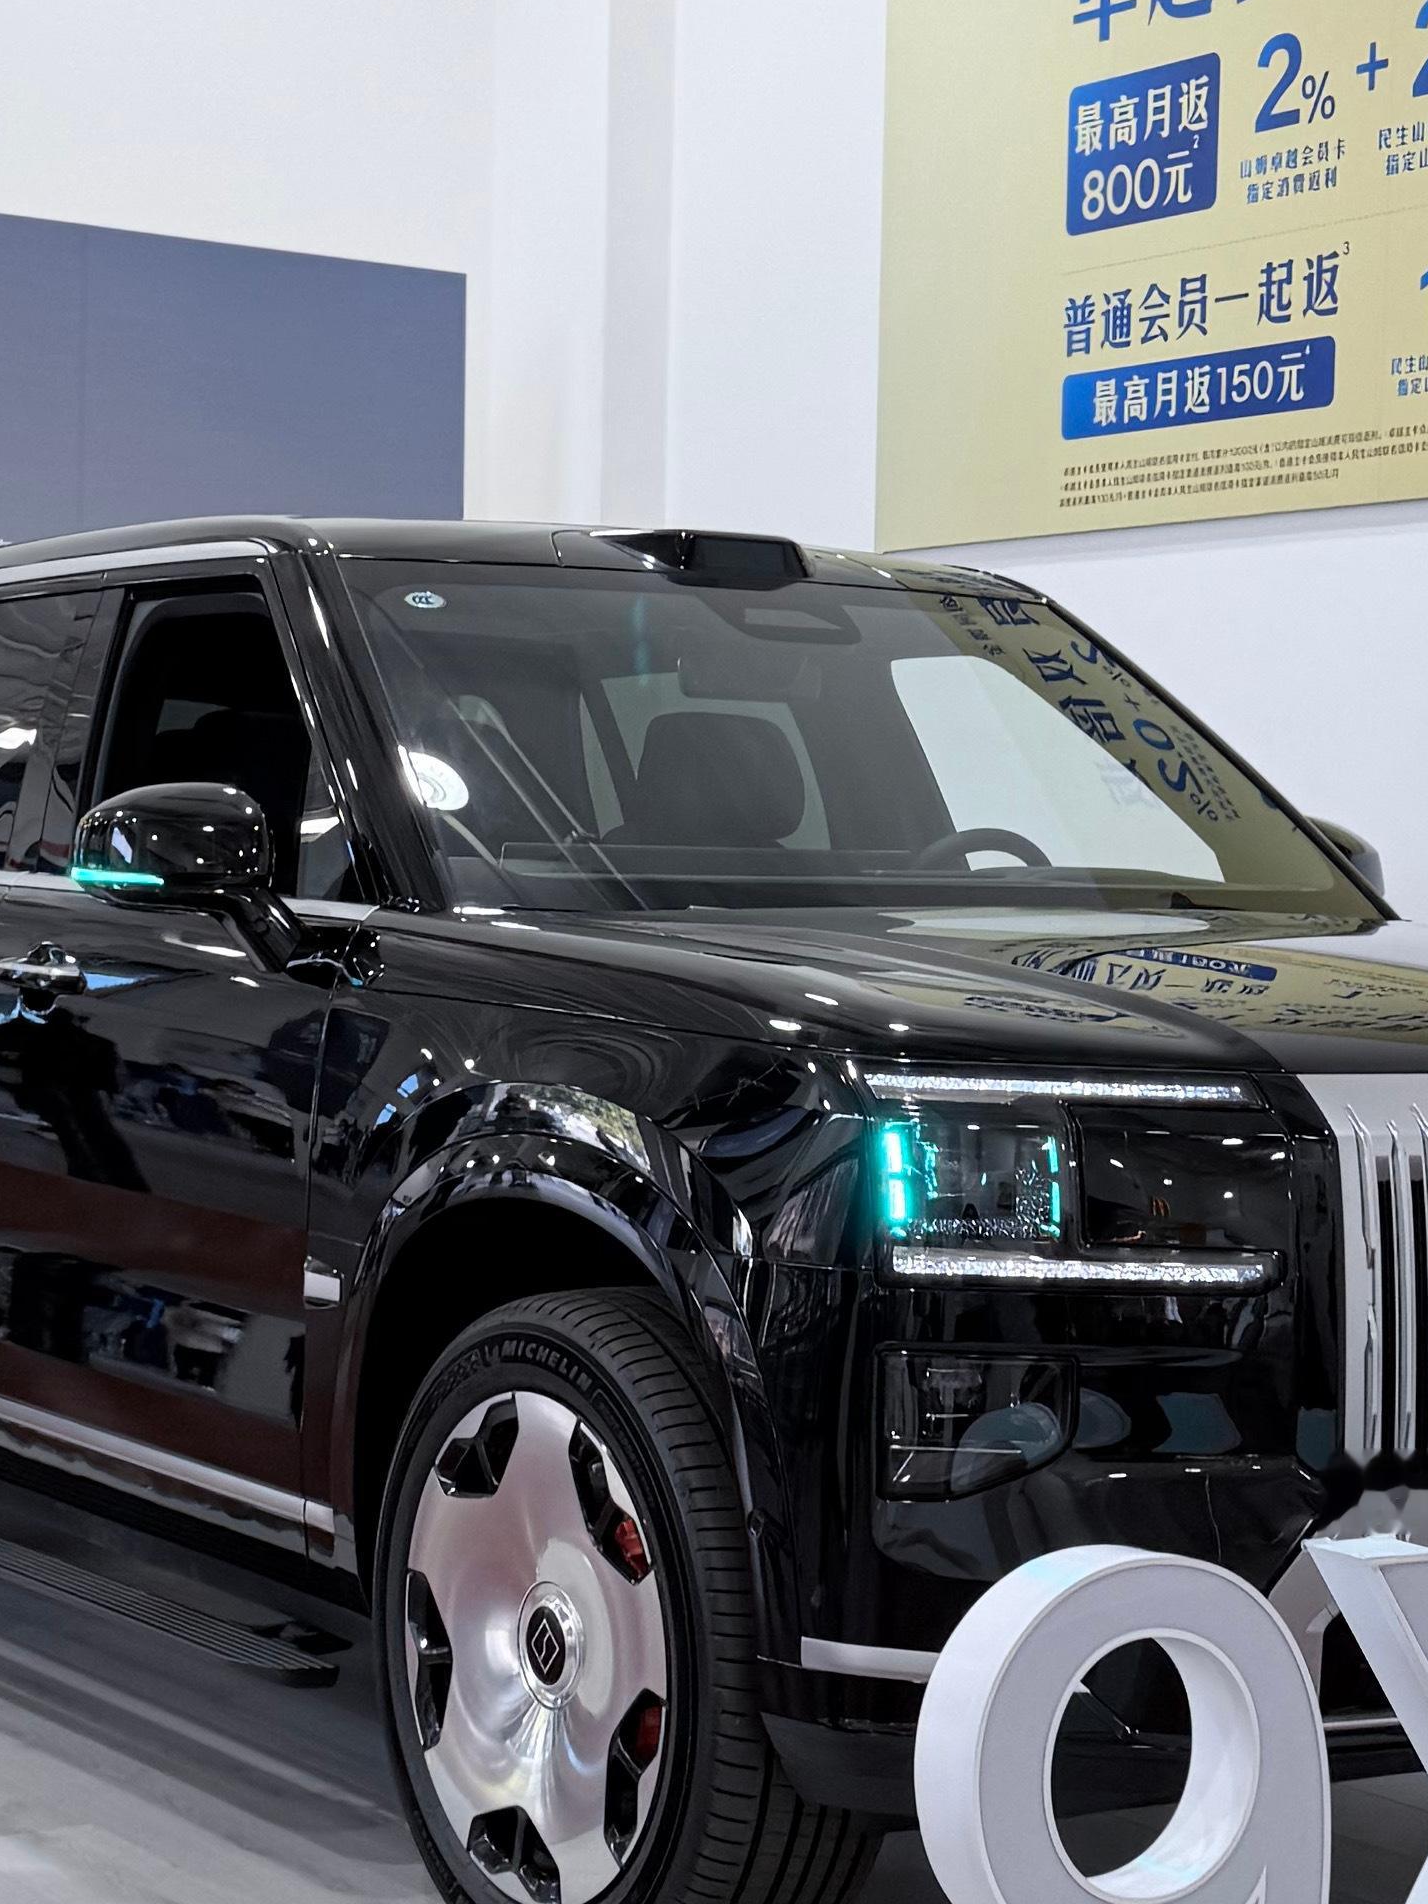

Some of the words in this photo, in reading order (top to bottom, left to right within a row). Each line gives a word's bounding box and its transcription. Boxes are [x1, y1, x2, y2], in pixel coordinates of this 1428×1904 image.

[1074, 74, 1210, 157] 最高月返
[1254, 32, 1336, 134] 2%
[1081, 149, 1194, 222] 800元
[1239, 137, 1347, 180] 山姆卓越会员卡
[1063, 250, 1340, 358] 普通会员一起返
[1092, 350, 1307, 428] 最高月返150元
[501, 1338, 594, 1393] MICHELIN
